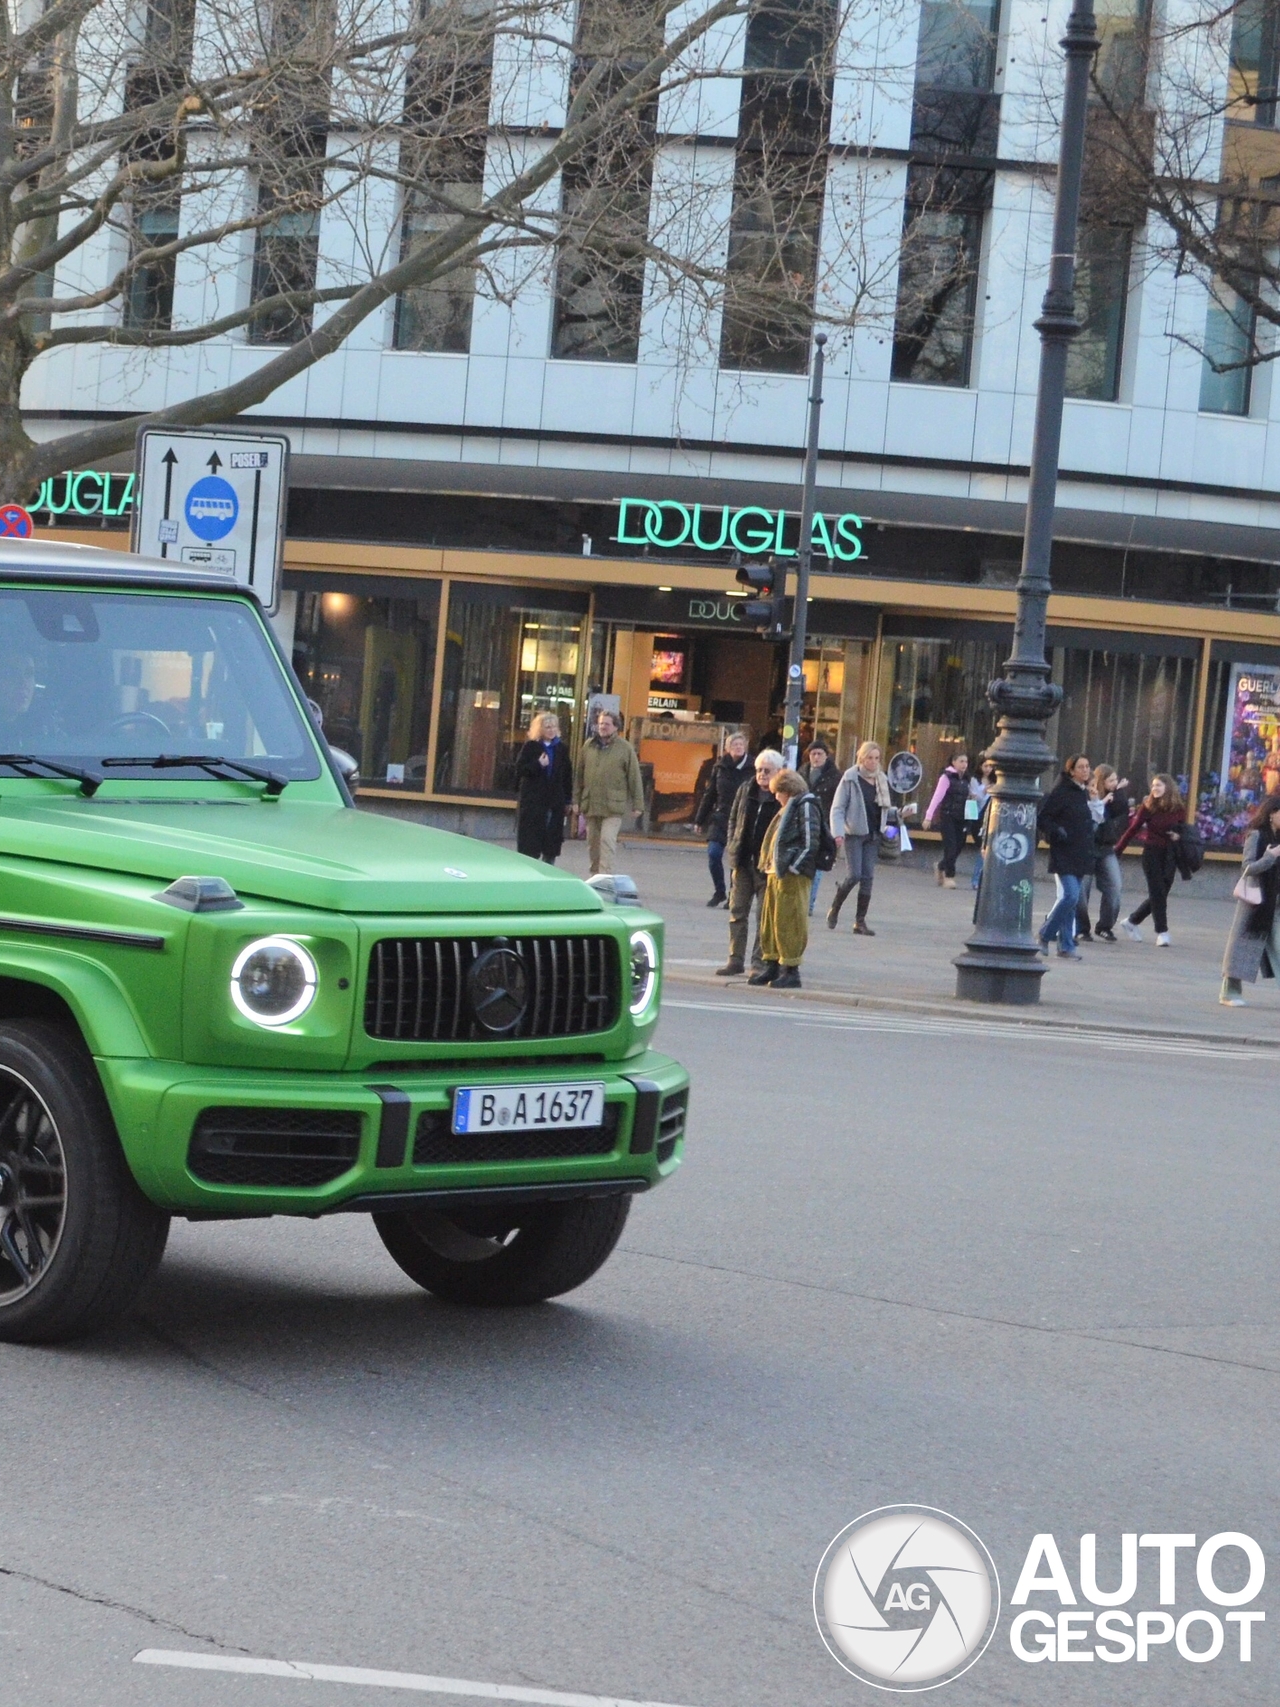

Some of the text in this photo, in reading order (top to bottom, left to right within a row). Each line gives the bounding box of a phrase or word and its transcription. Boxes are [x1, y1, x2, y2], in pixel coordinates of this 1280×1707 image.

[232, 453, 261, 468] POSER
[25, 470, 140, 515] UGLA
[617, 497, 862, 561] DOUGLAS
[480, 1094, 495, 1126] B
